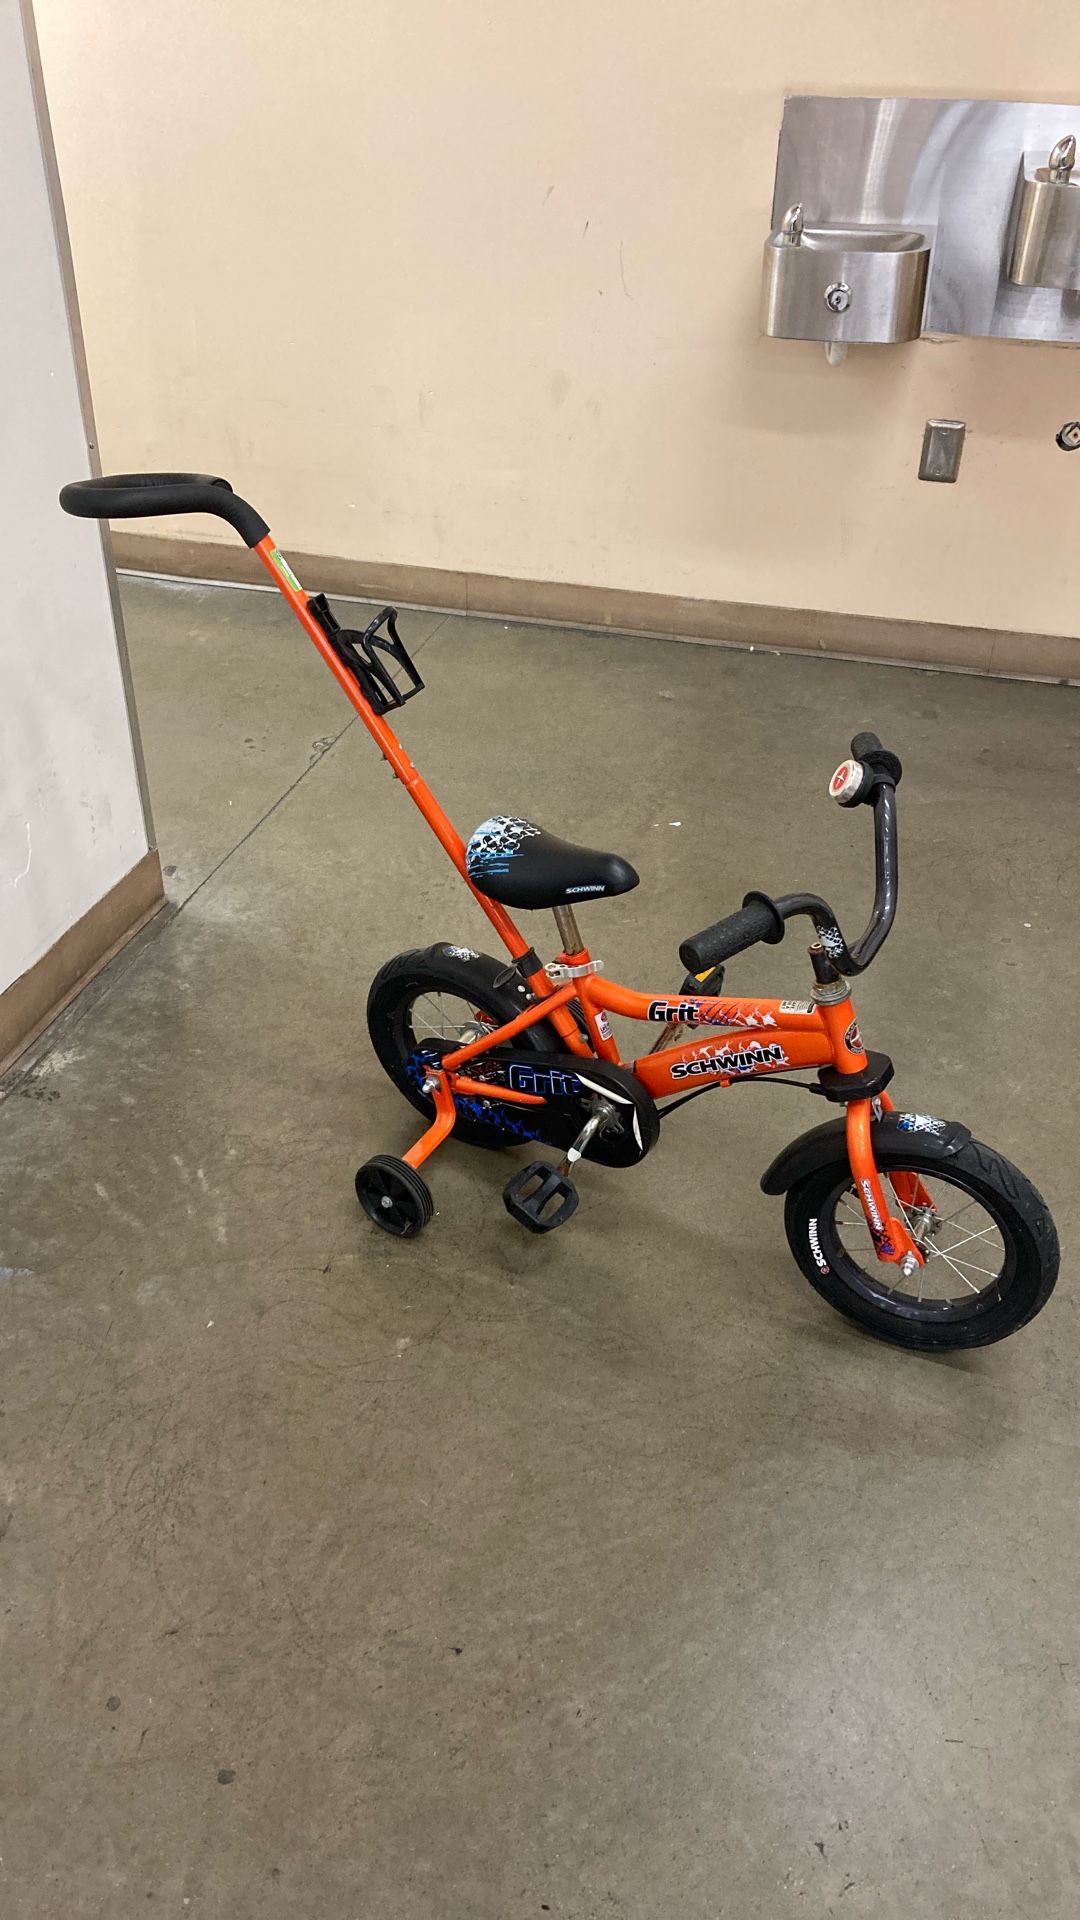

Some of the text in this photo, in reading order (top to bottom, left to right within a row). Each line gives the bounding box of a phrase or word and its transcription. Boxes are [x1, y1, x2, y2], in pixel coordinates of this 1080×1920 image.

[565, 885, 605, 895] SCHWINN
[648, 1000, 699, 1022] Grit
[670, 1045, 783, 1079] SCHWINN
[509, 1064, 579, 1096] Grit
[861, 1179, 884, 1231] SCHWINN
[808, 1218, 827, 1267] SCHWINN
